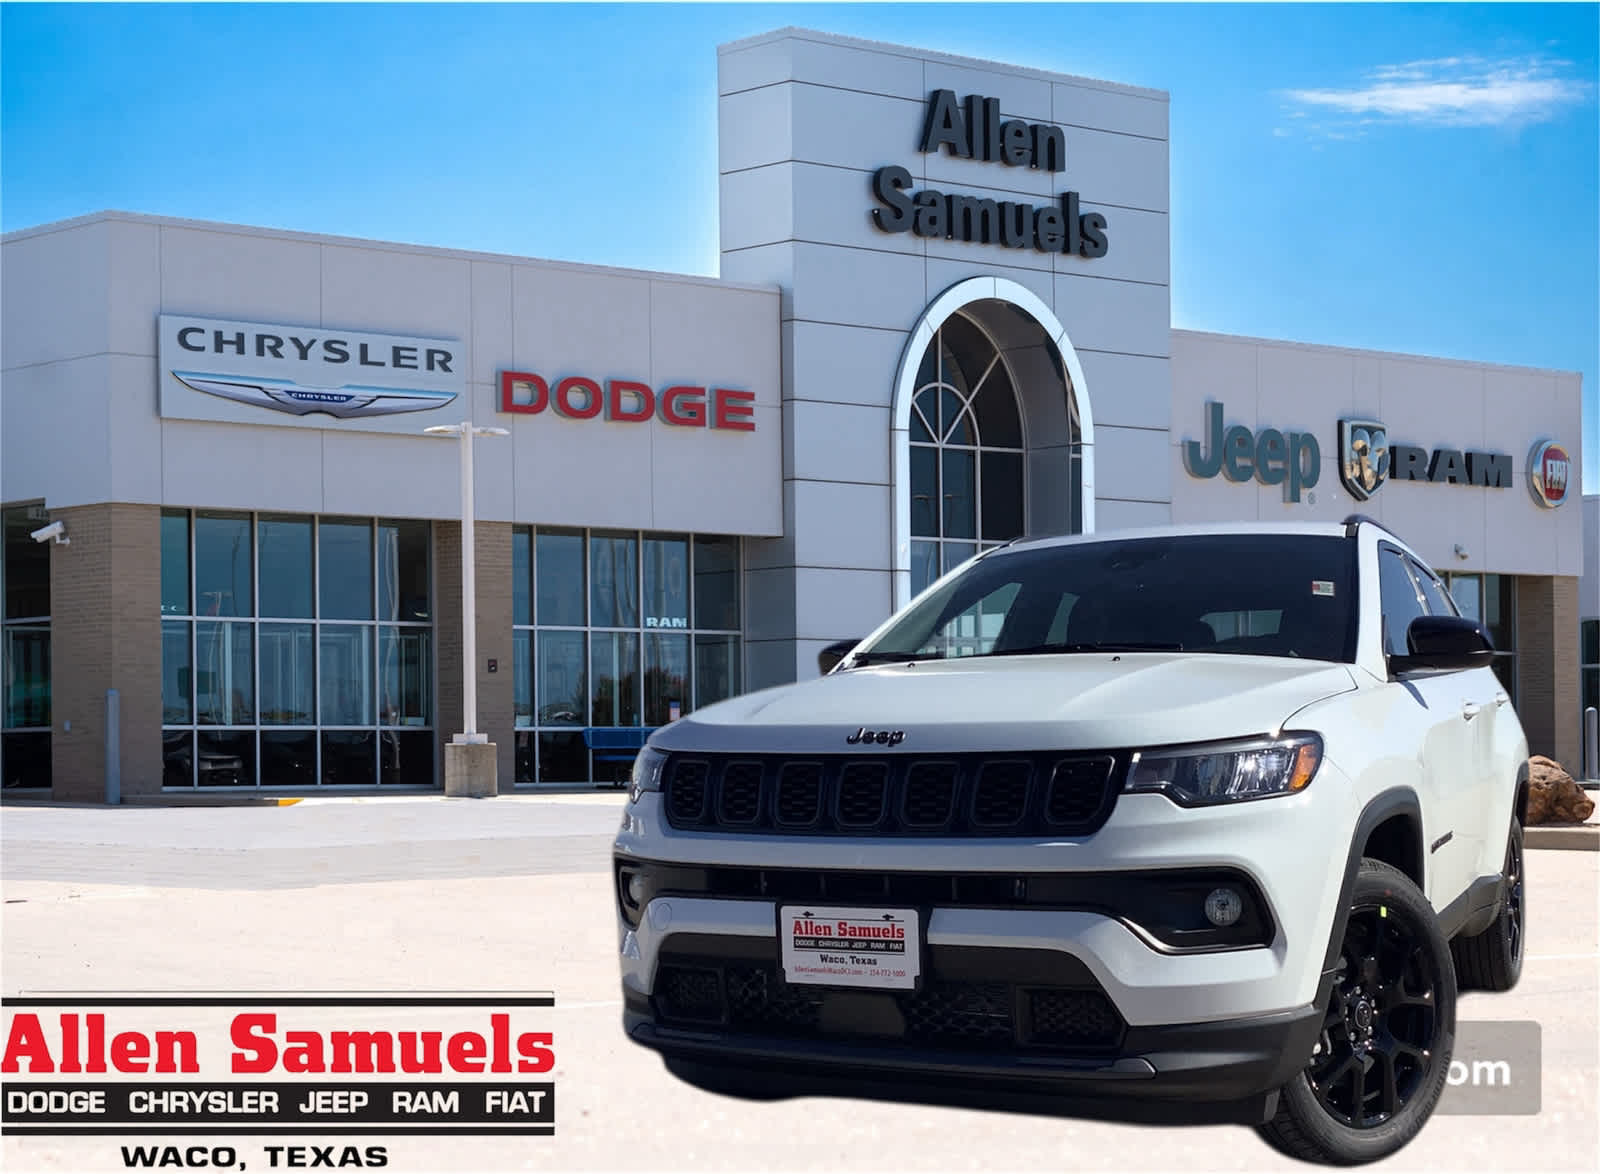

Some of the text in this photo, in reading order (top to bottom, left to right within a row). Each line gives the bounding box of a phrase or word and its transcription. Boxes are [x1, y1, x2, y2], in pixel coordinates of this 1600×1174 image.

[918, 89, 1066, 172] Allen
[872, 165, 1108, 258] Samuels
[176, 326, 454, 374] CHRYSLER
[291, 392, 347, 402] CHRYSLER
[496, 370, 756, 432] DODGE
[1182, 401, 1321, 503] Jeep
[1389, 445, 1513, 488] RAM
[646, 617, 687, 628] RAM
[846, 728, 906, 747] Jeep
[793, 920, 905, 939] Allen Samuels
[820, 954, 878, 966] Waco, Texas
